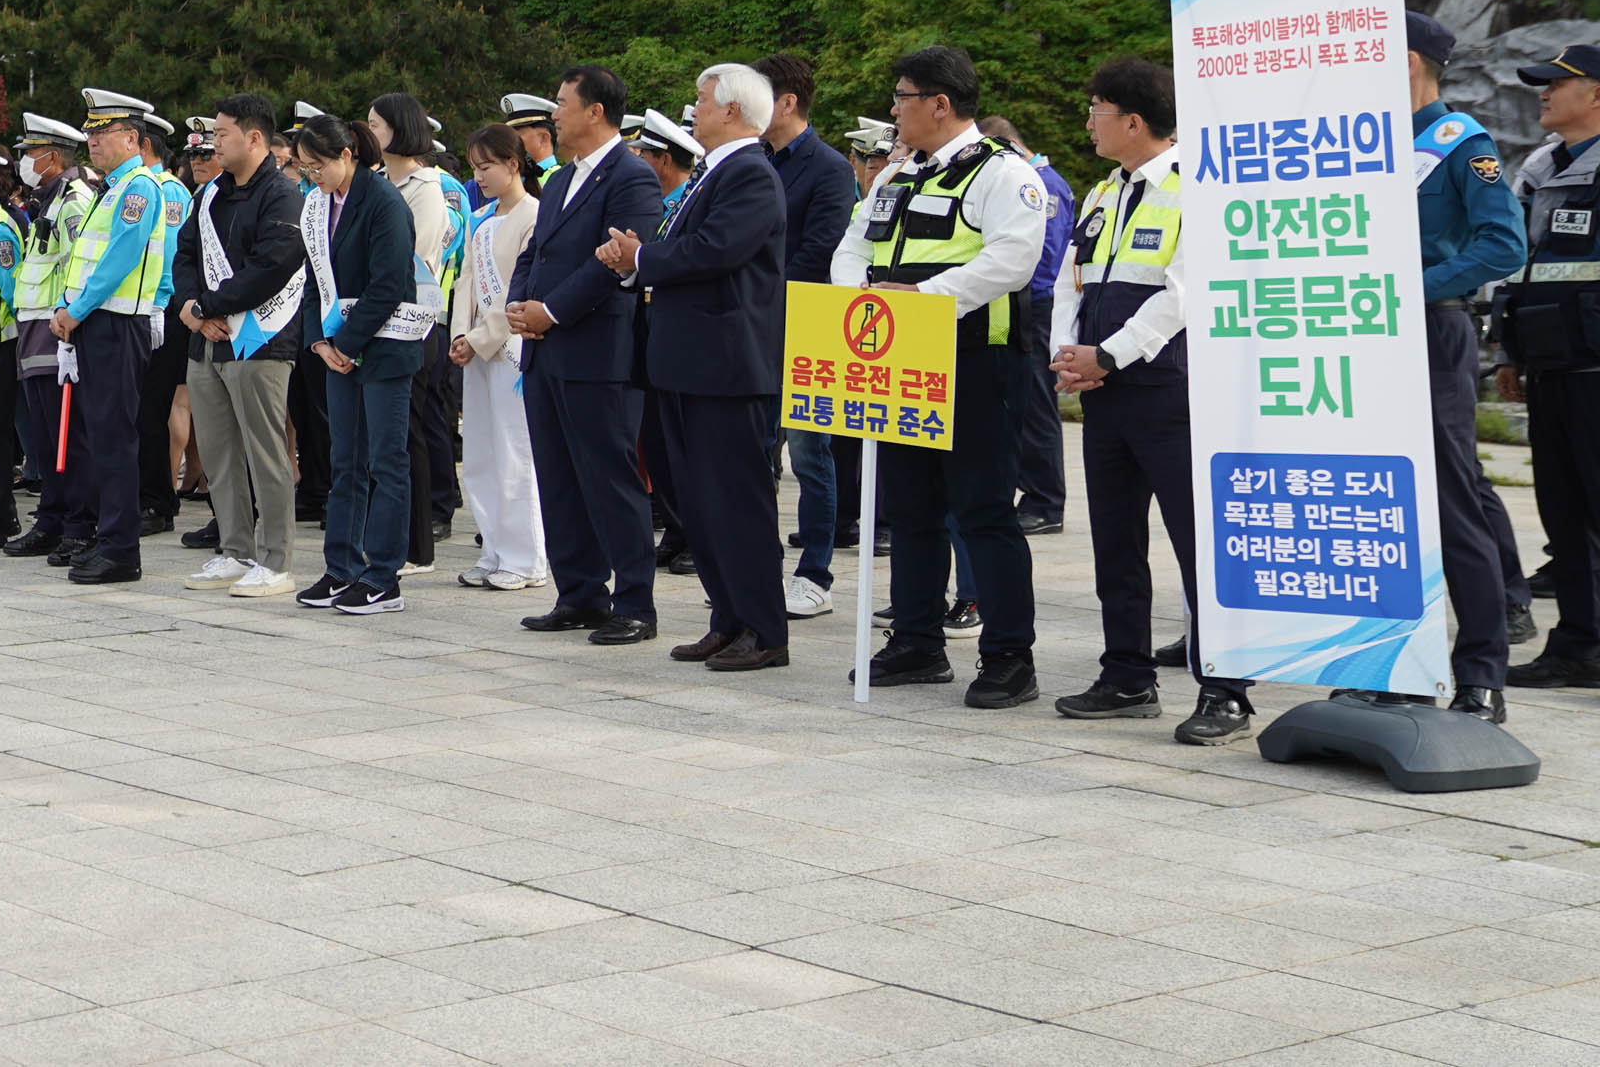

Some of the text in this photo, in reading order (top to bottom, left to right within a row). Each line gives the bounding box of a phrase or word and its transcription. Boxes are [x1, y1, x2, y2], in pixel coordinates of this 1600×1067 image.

[1192, 6, 1389, 49] 목포해상케이블카와 함께하는
[1197, 38, 1386, 78] 2000만 관광도시 목포 조성
[1195, 111, 1395, 184] 사람중심의
[1223, 192, 1371, 261] 안전한
[1208, 273, 1401, 340] 교통문화
[790, 355, 948, 404] 음주 운전 근절
[1259, 355, 1355, 419] 도시
[789, 393, 946, 441] 교통 법규 준수
[1228, 467, 1394, 499] 살기 좋은 도시
[1223, 501, 1405, 535] 목포를 만드는데
[1225, 535, 1408, 569] 여러분의 동참이
[1253, 571, 1379, 604] 필요합니다
